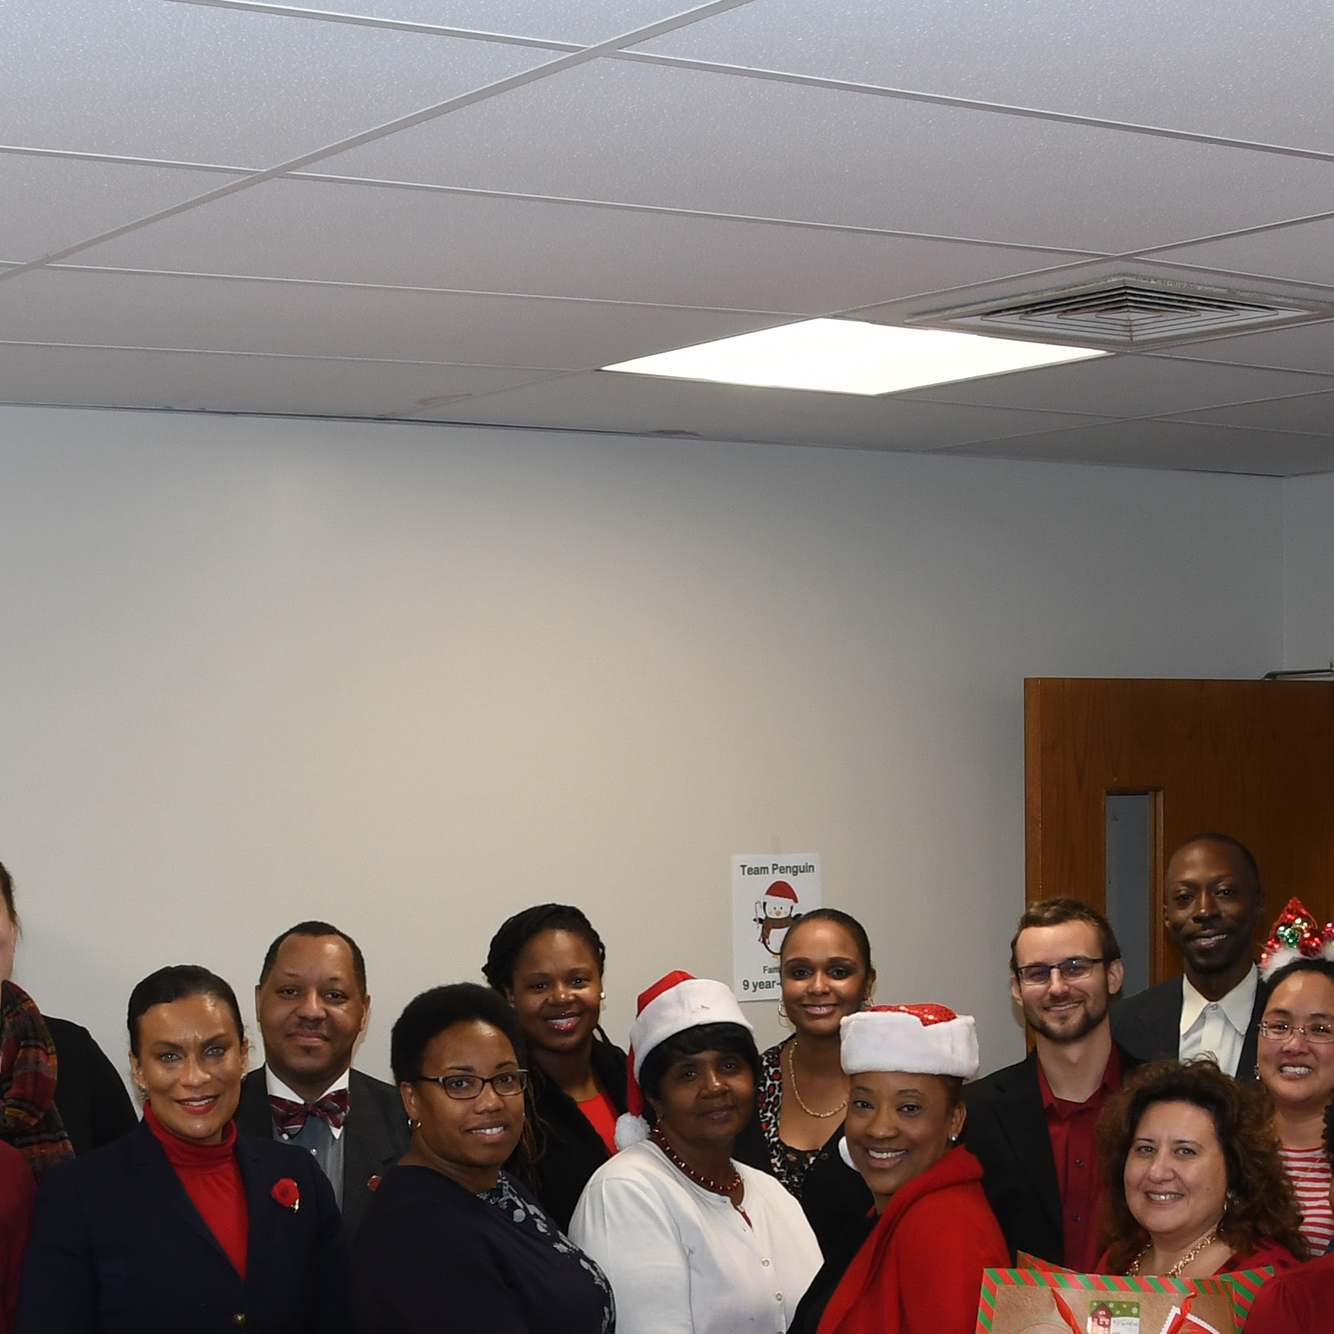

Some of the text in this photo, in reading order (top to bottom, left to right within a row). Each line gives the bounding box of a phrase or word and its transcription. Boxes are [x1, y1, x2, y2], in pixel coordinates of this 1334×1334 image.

[739, 862, 815, 876] Team Penguin
[763, 965, 781, 974] Fam
[742, 979, 782, 993] 9 year-
